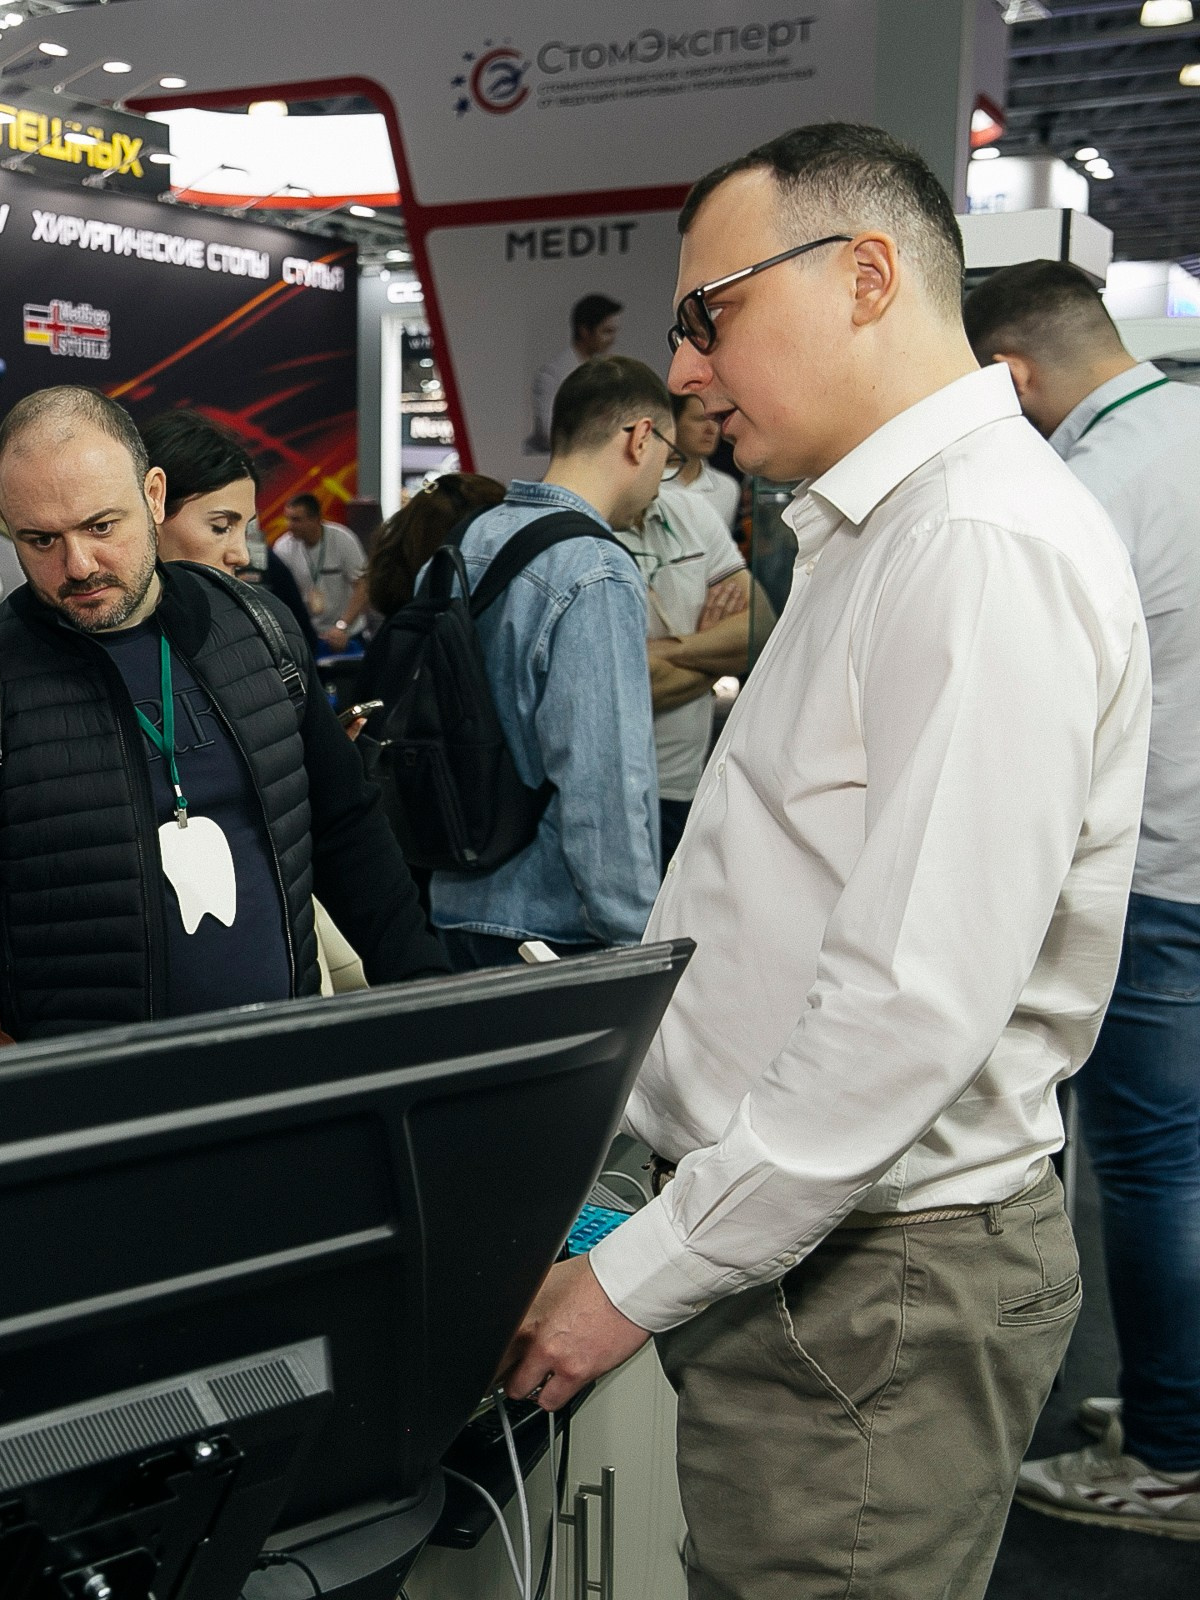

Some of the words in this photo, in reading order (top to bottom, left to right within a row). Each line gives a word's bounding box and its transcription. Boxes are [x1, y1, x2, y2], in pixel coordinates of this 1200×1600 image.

[537, 15, 819, 74] СтомЭксперт
[32, 209, 205, 269] ХИРУРГИЧЕСКИЕ
[206, 243, 270, 280] СТОЛЫ
[506, 222, 638, 261] MEDIT
